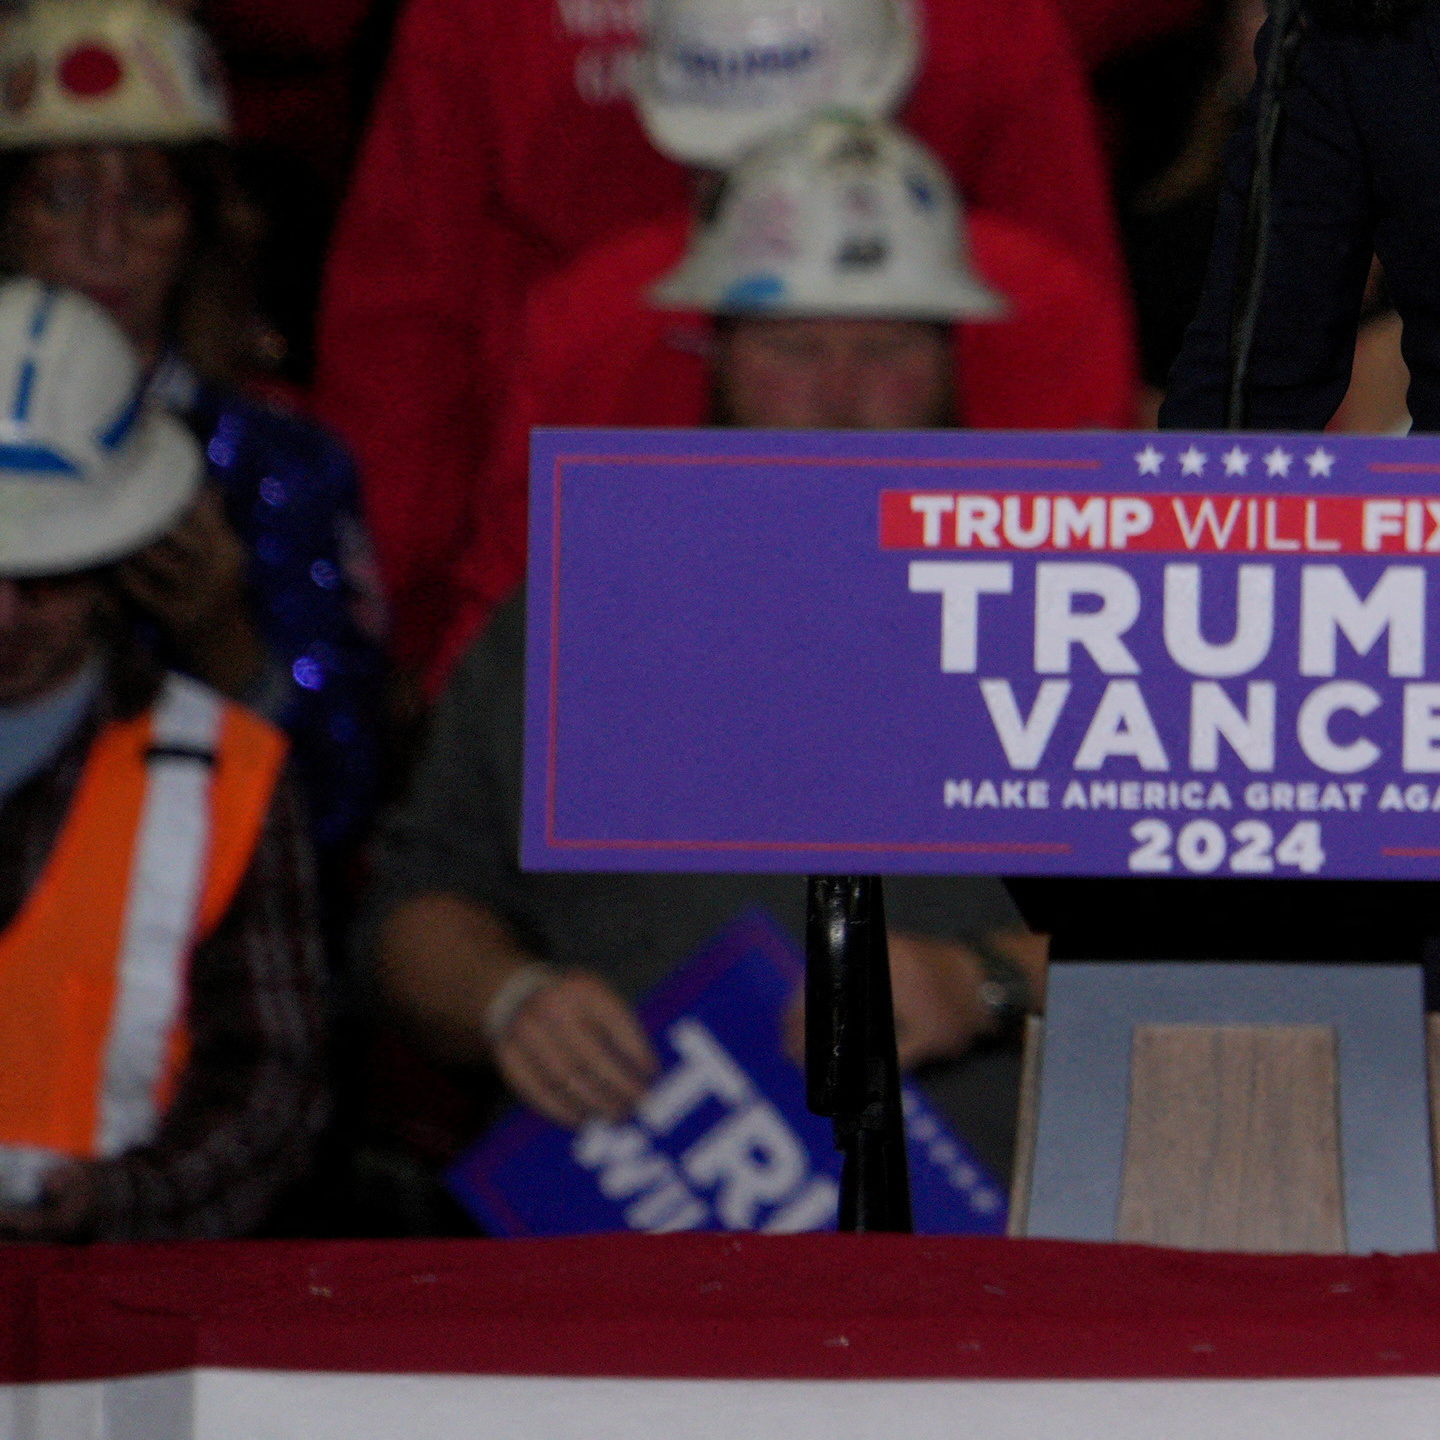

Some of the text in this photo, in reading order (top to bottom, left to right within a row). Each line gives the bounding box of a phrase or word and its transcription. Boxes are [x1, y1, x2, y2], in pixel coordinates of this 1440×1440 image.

[910, 494, 1154, 549] TRUMP
[1172, 496, 1341, 551] WILL
[943, 778, 1051, 811] MAKE
[1061, 779, 1232, 812] AMERICA
[1244, 781, 1368, 813] GREAT
[1127, 817, 1326, 875] 2024
